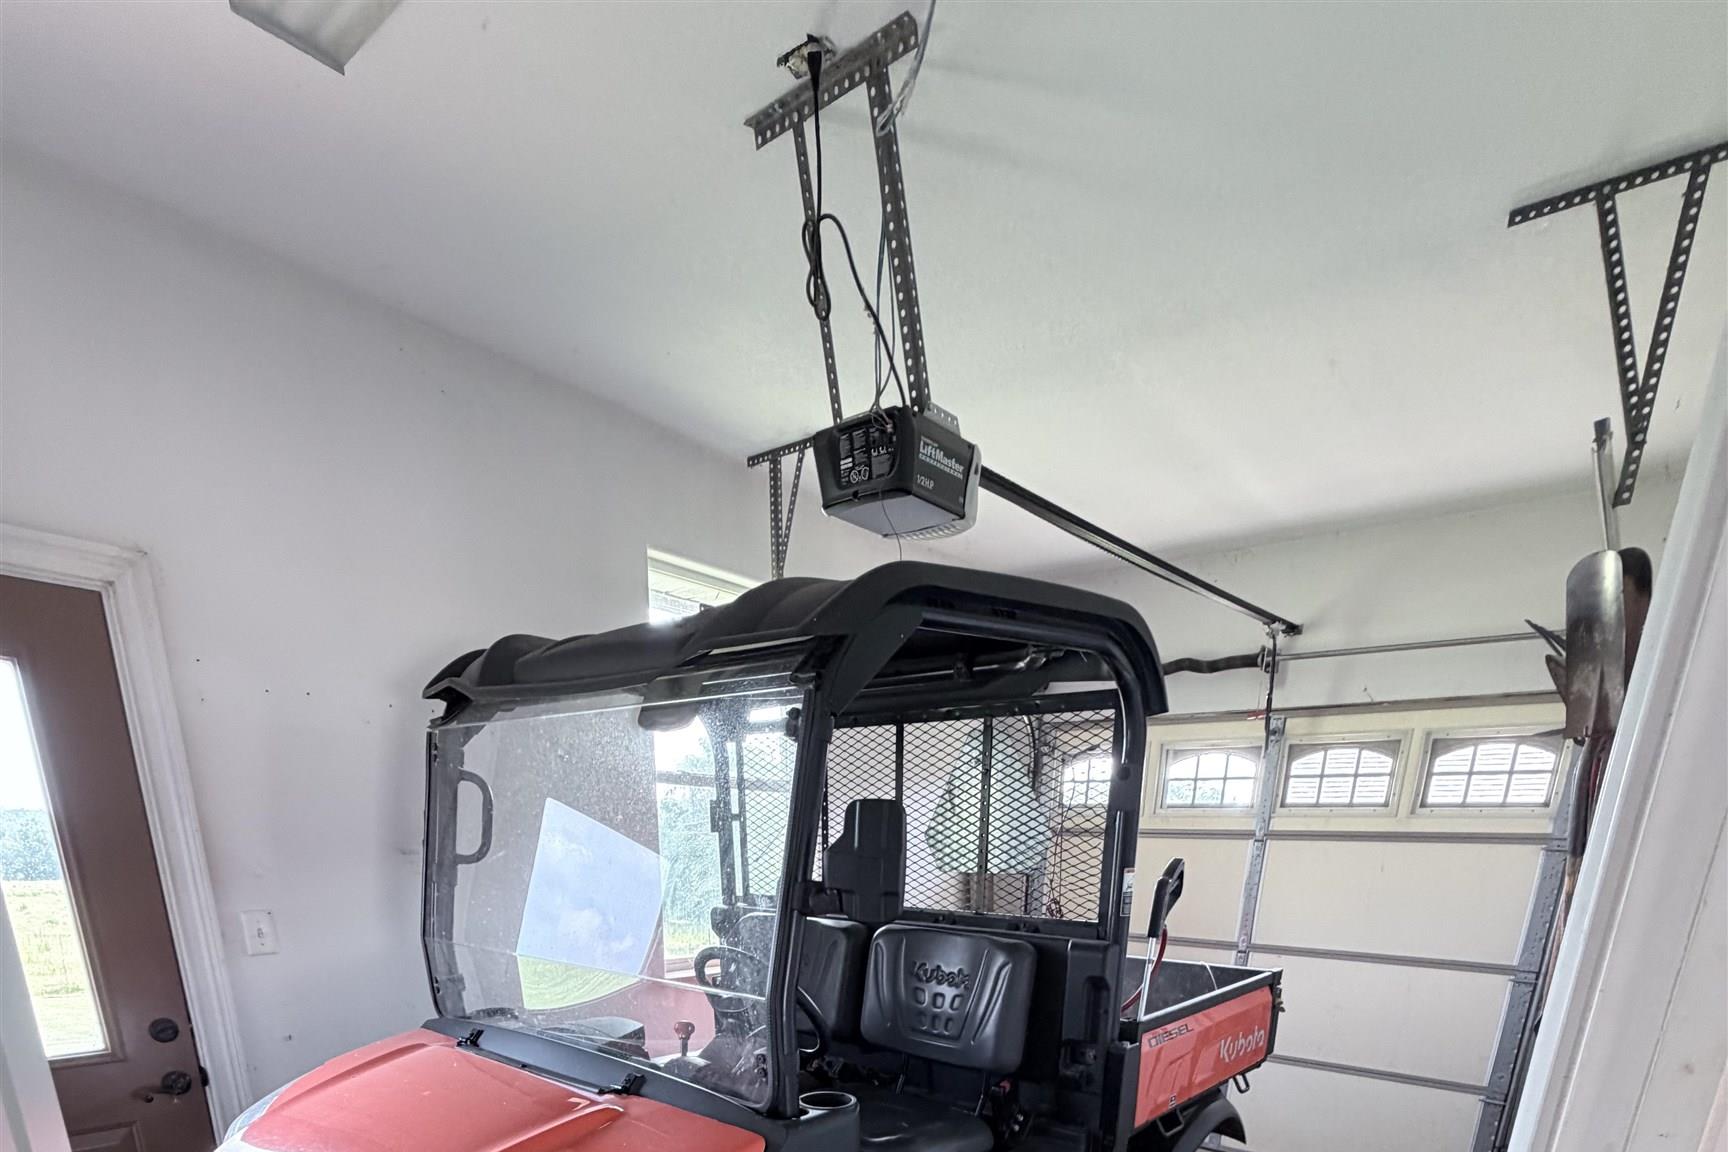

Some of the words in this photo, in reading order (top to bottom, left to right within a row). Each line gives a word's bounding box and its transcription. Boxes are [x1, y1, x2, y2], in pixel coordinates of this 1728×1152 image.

[919, 439, 965, 473] LiftMaster
[1147, 1023, 1194, 1048] DIESEL
[1218, 1025, 1266, 1063] Kubota
